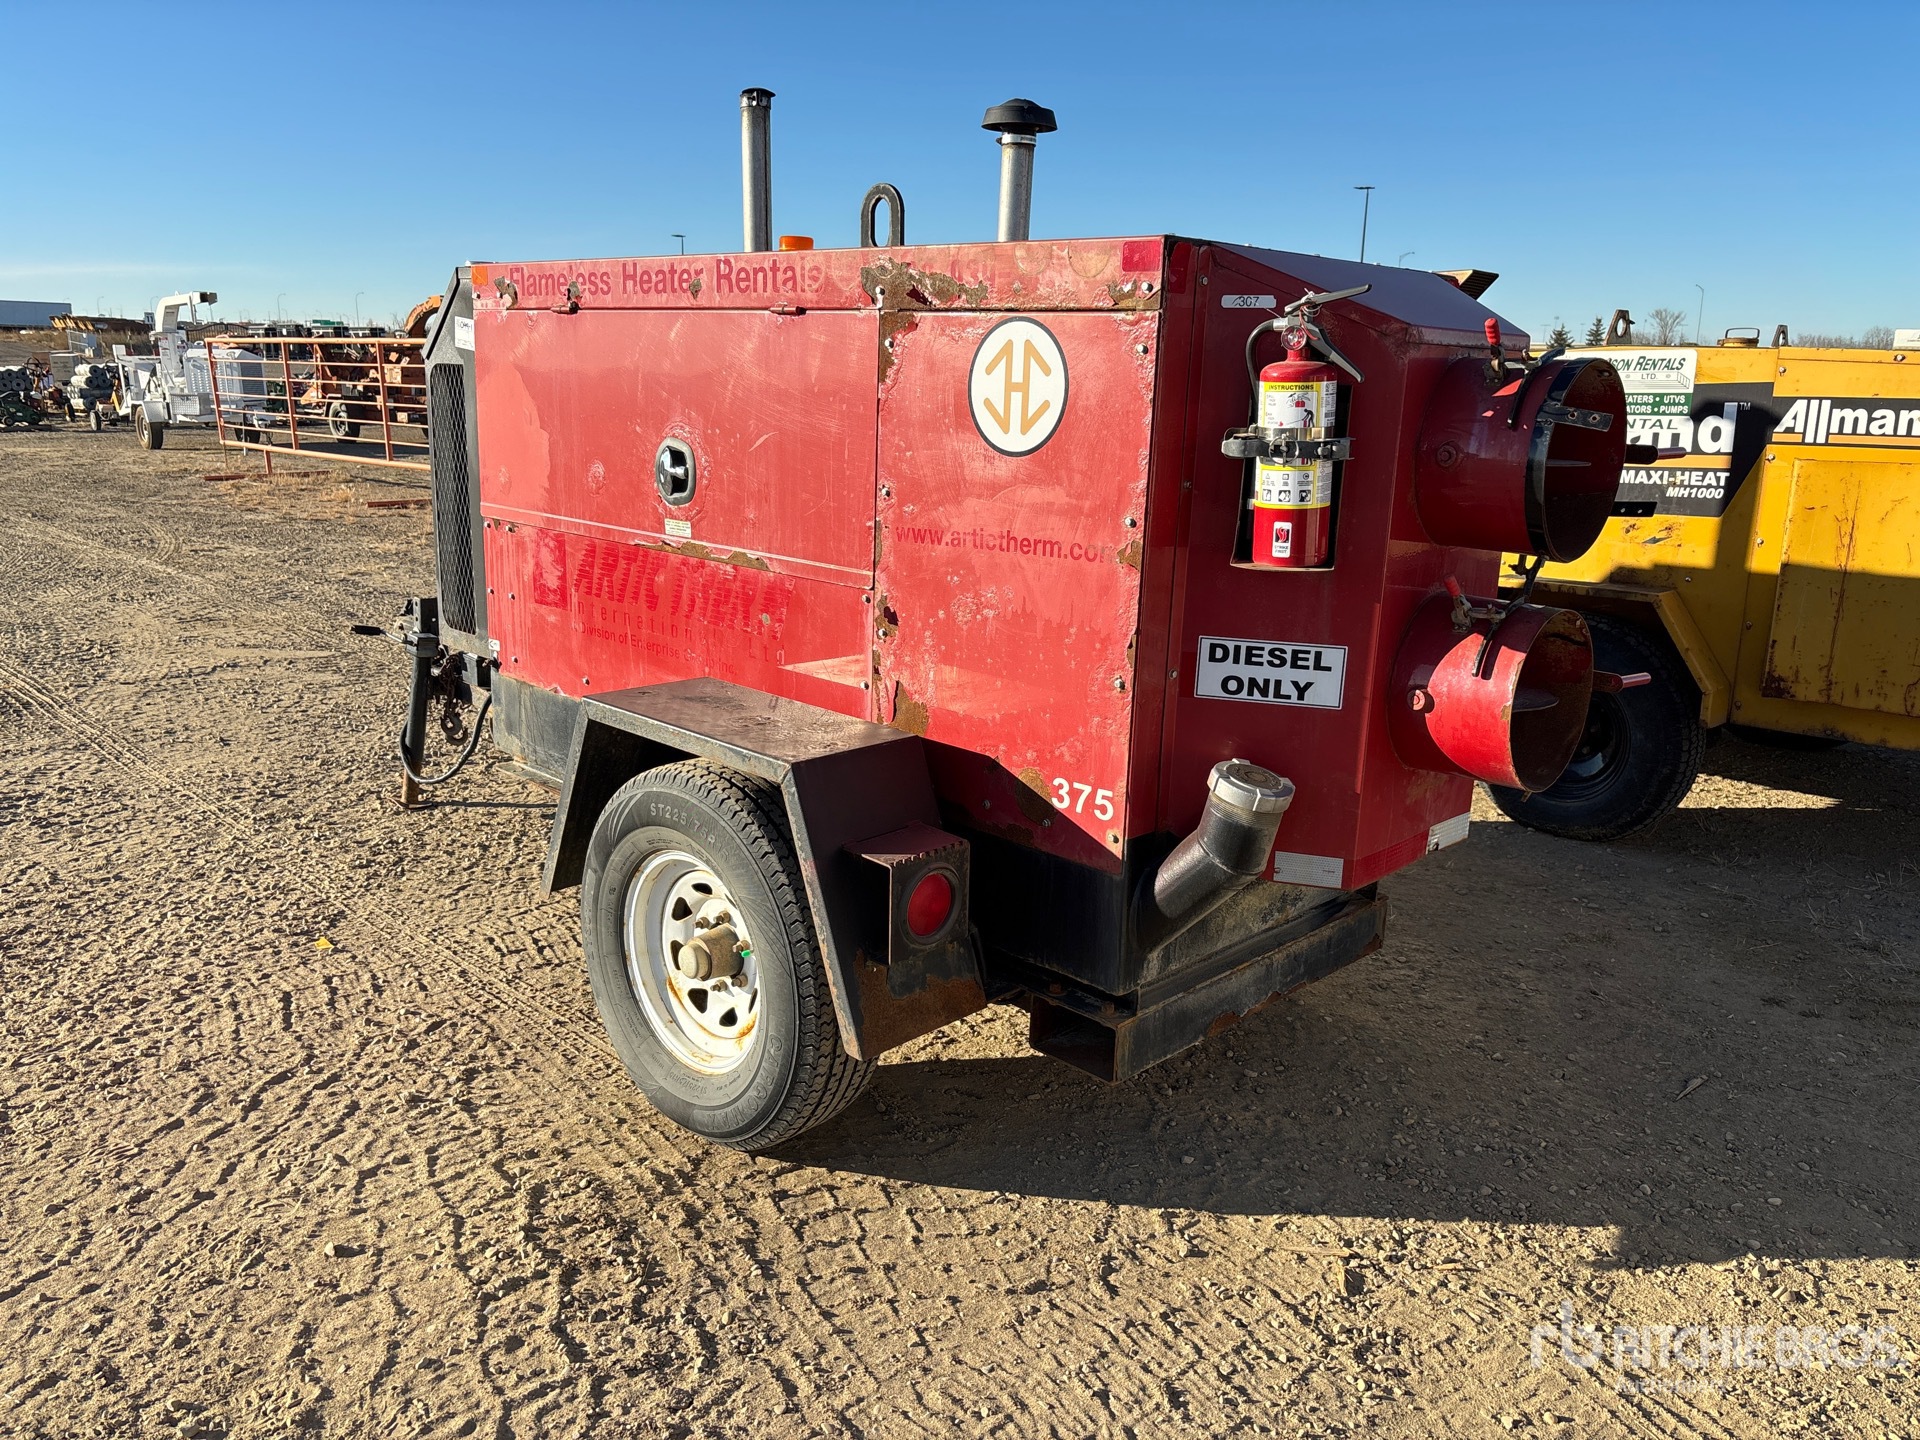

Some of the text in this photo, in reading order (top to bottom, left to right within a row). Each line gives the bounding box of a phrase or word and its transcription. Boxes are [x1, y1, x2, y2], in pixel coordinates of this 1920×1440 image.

[622, 262, 704, 296] Heater
[716, 258, 824, 295] Rentals
[1634, 356, 1686, 371] RENTALS
[1660, 405, 1689, 414] PUMPS
[1663, 395, 1686, 404] UTVS
[1620, 469, 1731, 488] MAXI-HEAT
[1666, 486, 1725, 499] MH1000
[581, 621, 616, 642] Division
[618, 631, 629, 645] of
[630, 633, 680, 660] Enterprise
[1208, 642, 1332, 672] DIESEL
[1220, 675, 1315, 701] ONLY
[1051, 777, 1114, 821] 375
